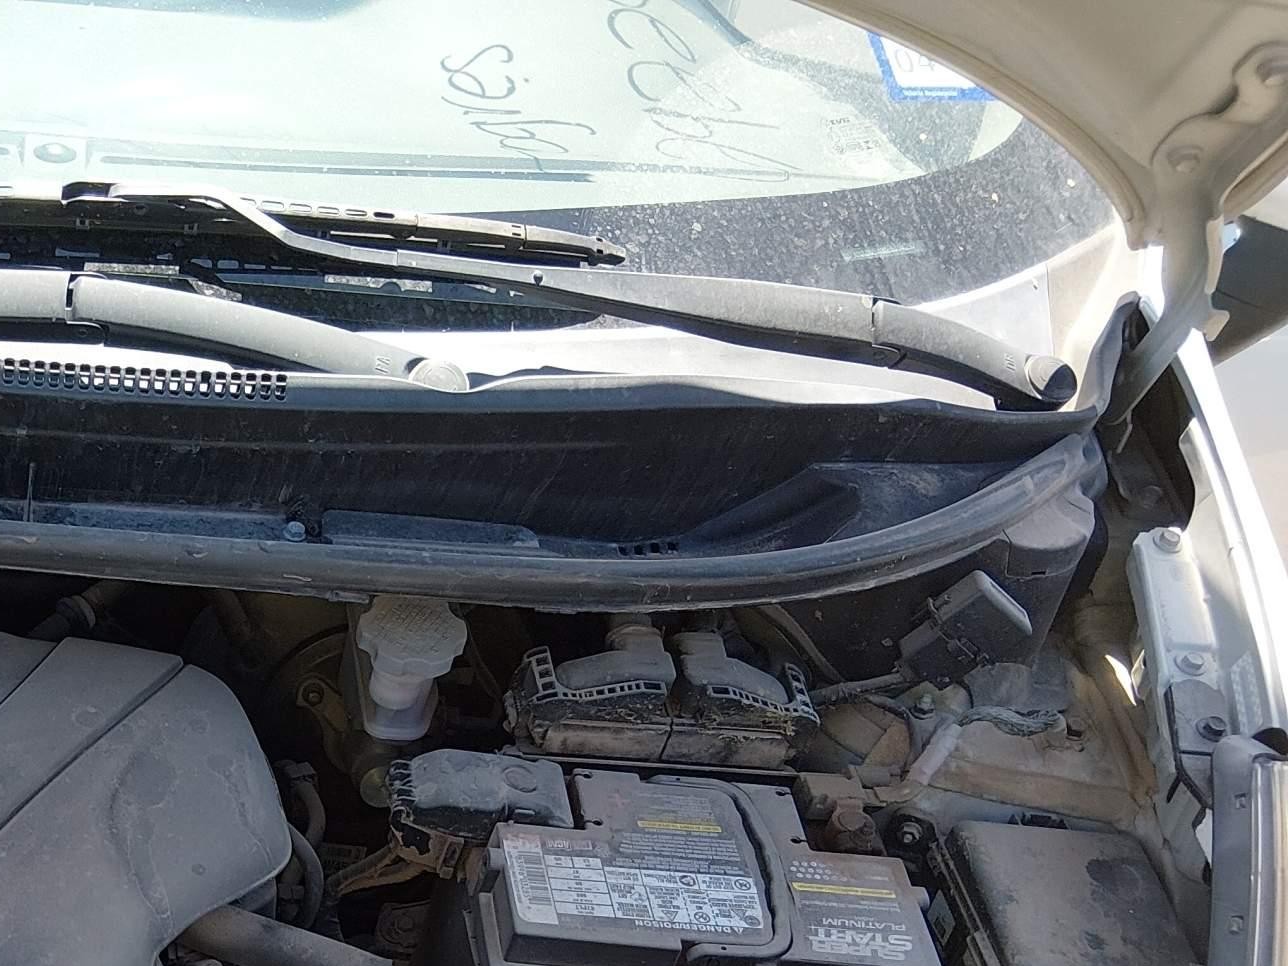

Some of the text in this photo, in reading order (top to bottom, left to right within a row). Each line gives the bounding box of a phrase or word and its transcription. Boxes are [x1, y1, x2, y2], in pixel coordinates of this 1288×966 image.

[635, 919, 731, 931] DANGER/POISON
[822, 917, 906, 931] PLATINUM
[808, 928, 912, 951] START
[812, 940, 905, 960] SUPER
